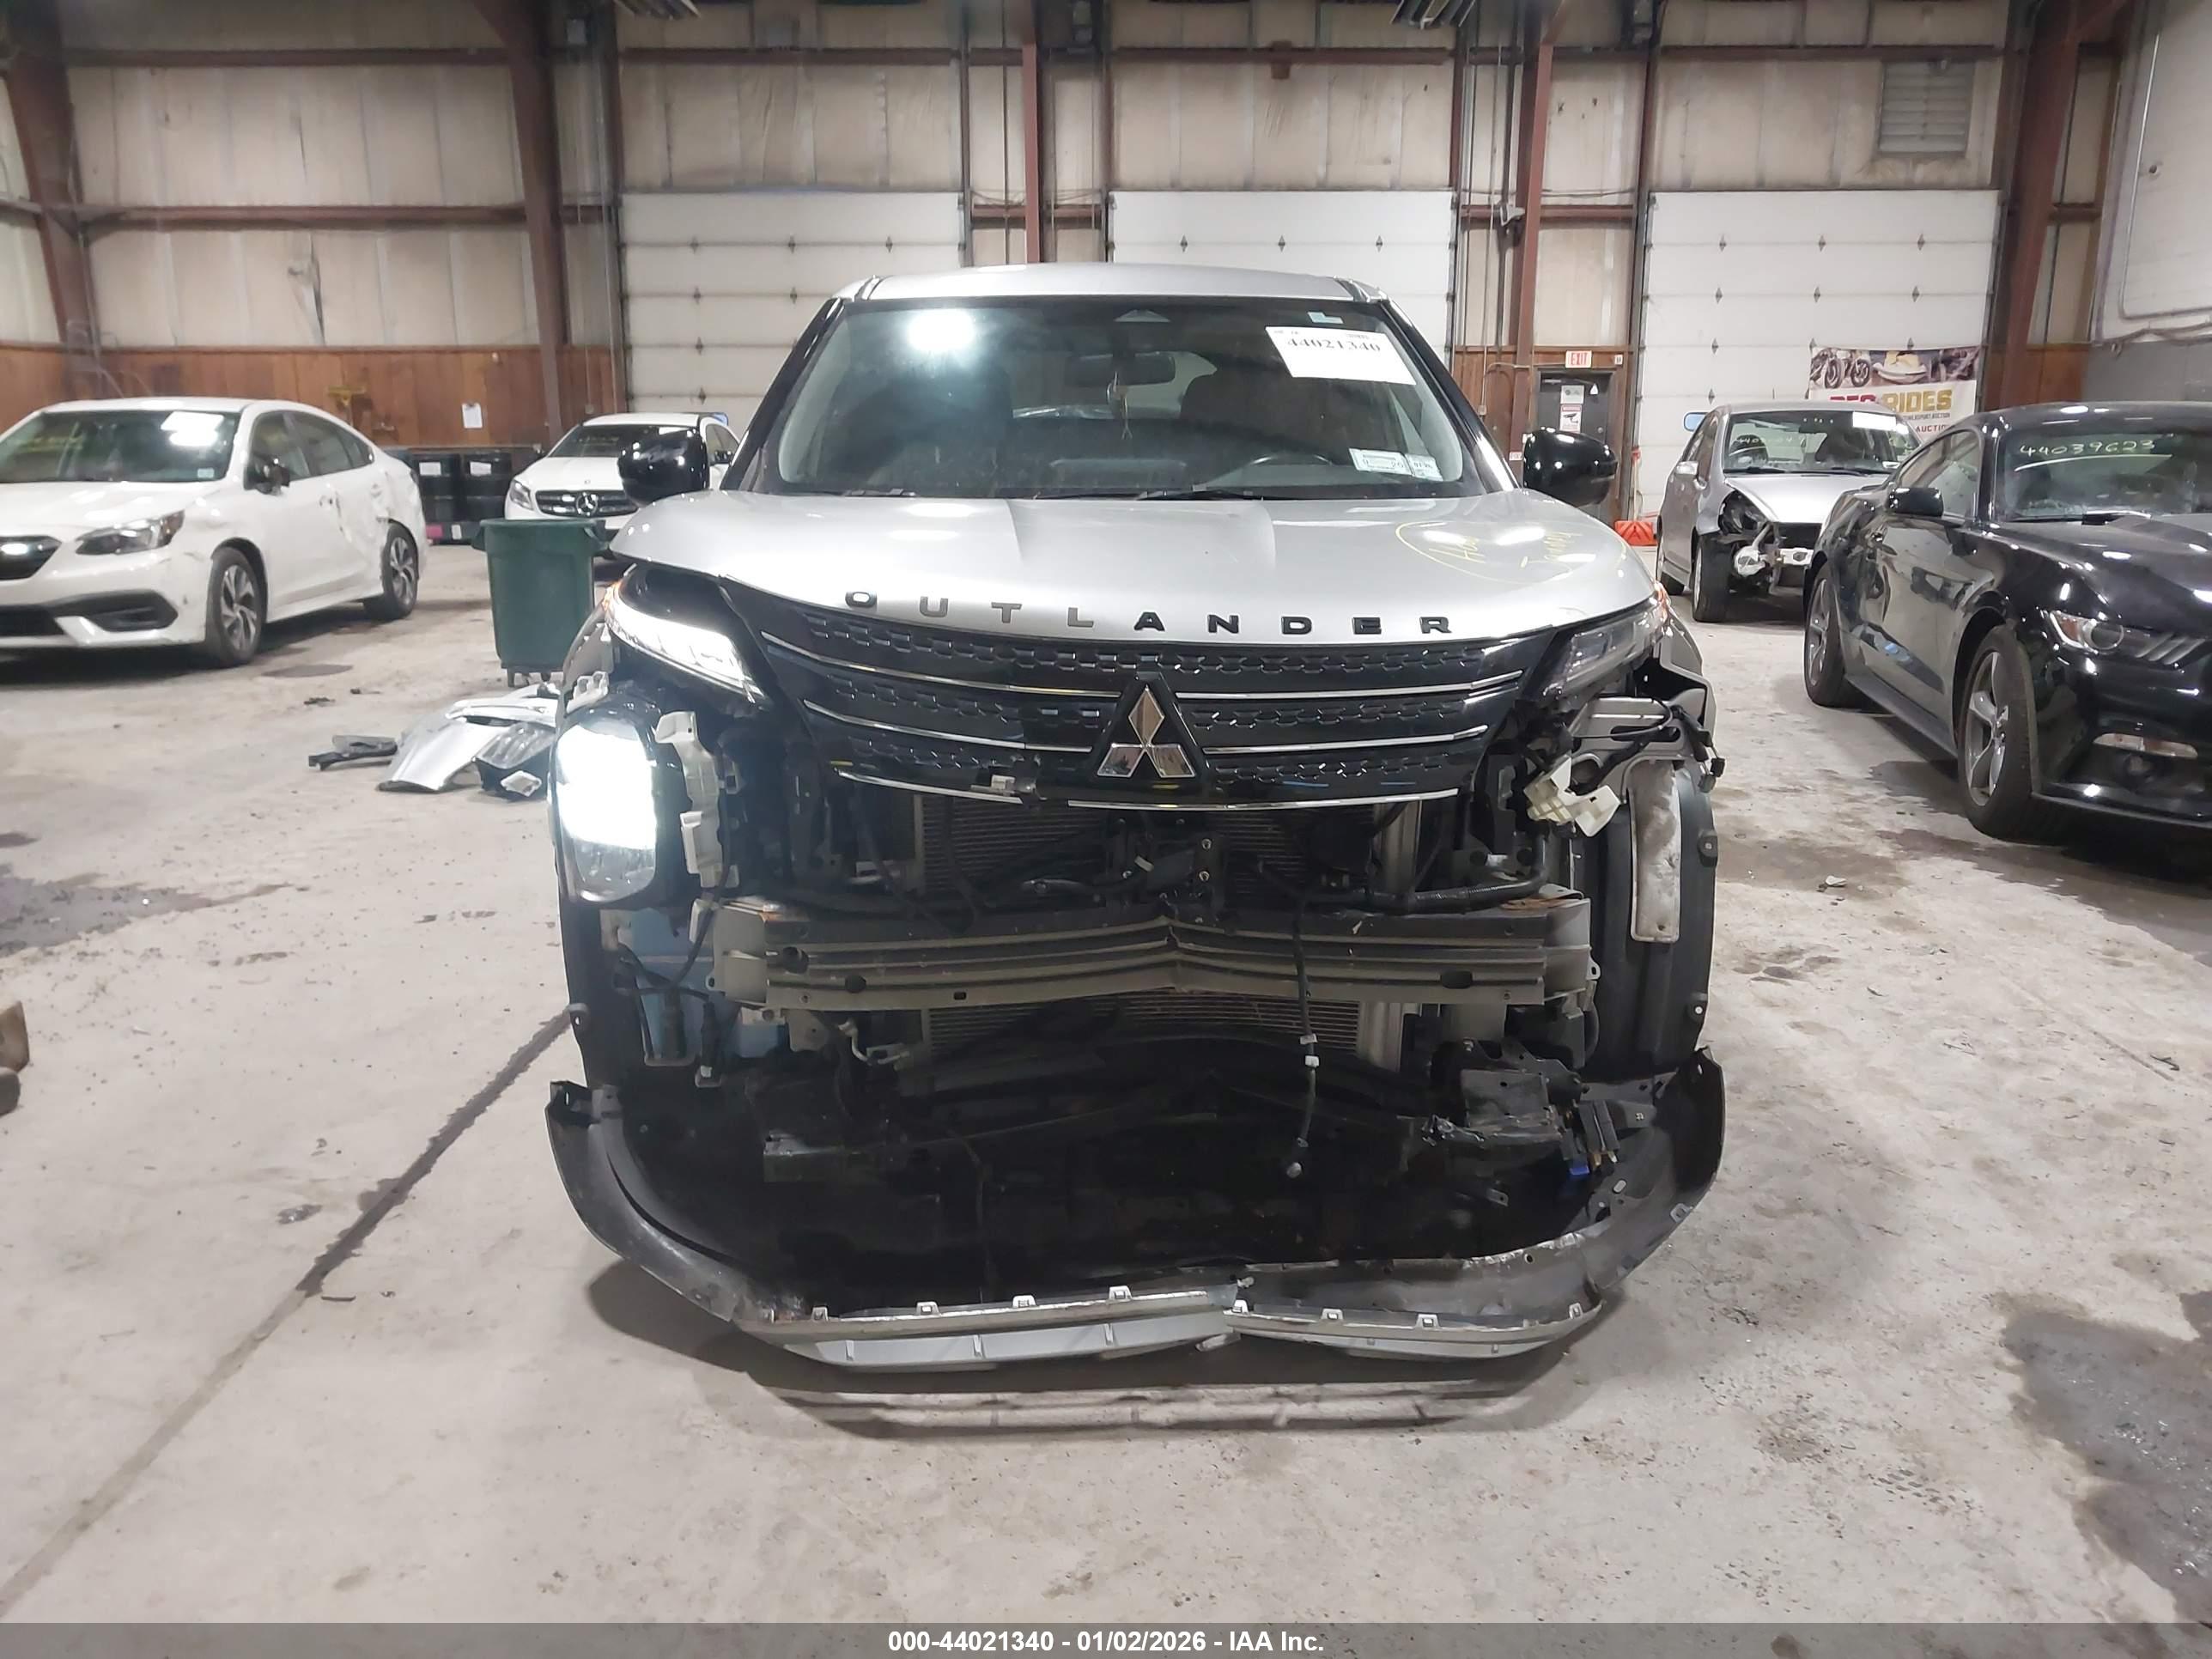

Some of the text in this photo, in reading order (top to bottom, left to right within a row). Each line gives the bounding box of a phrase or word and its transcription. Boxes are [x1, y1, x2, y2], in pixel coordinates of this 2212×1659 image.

[1288, 338, 1380, 351] 44021340
[1571, 352, 1588, 365] EXIT
[1881, 390, 1952, 412] RIDES
[2020, 440, 2155, 457] 44039623
[845, 591, 1451, 634] OUTLANDER
